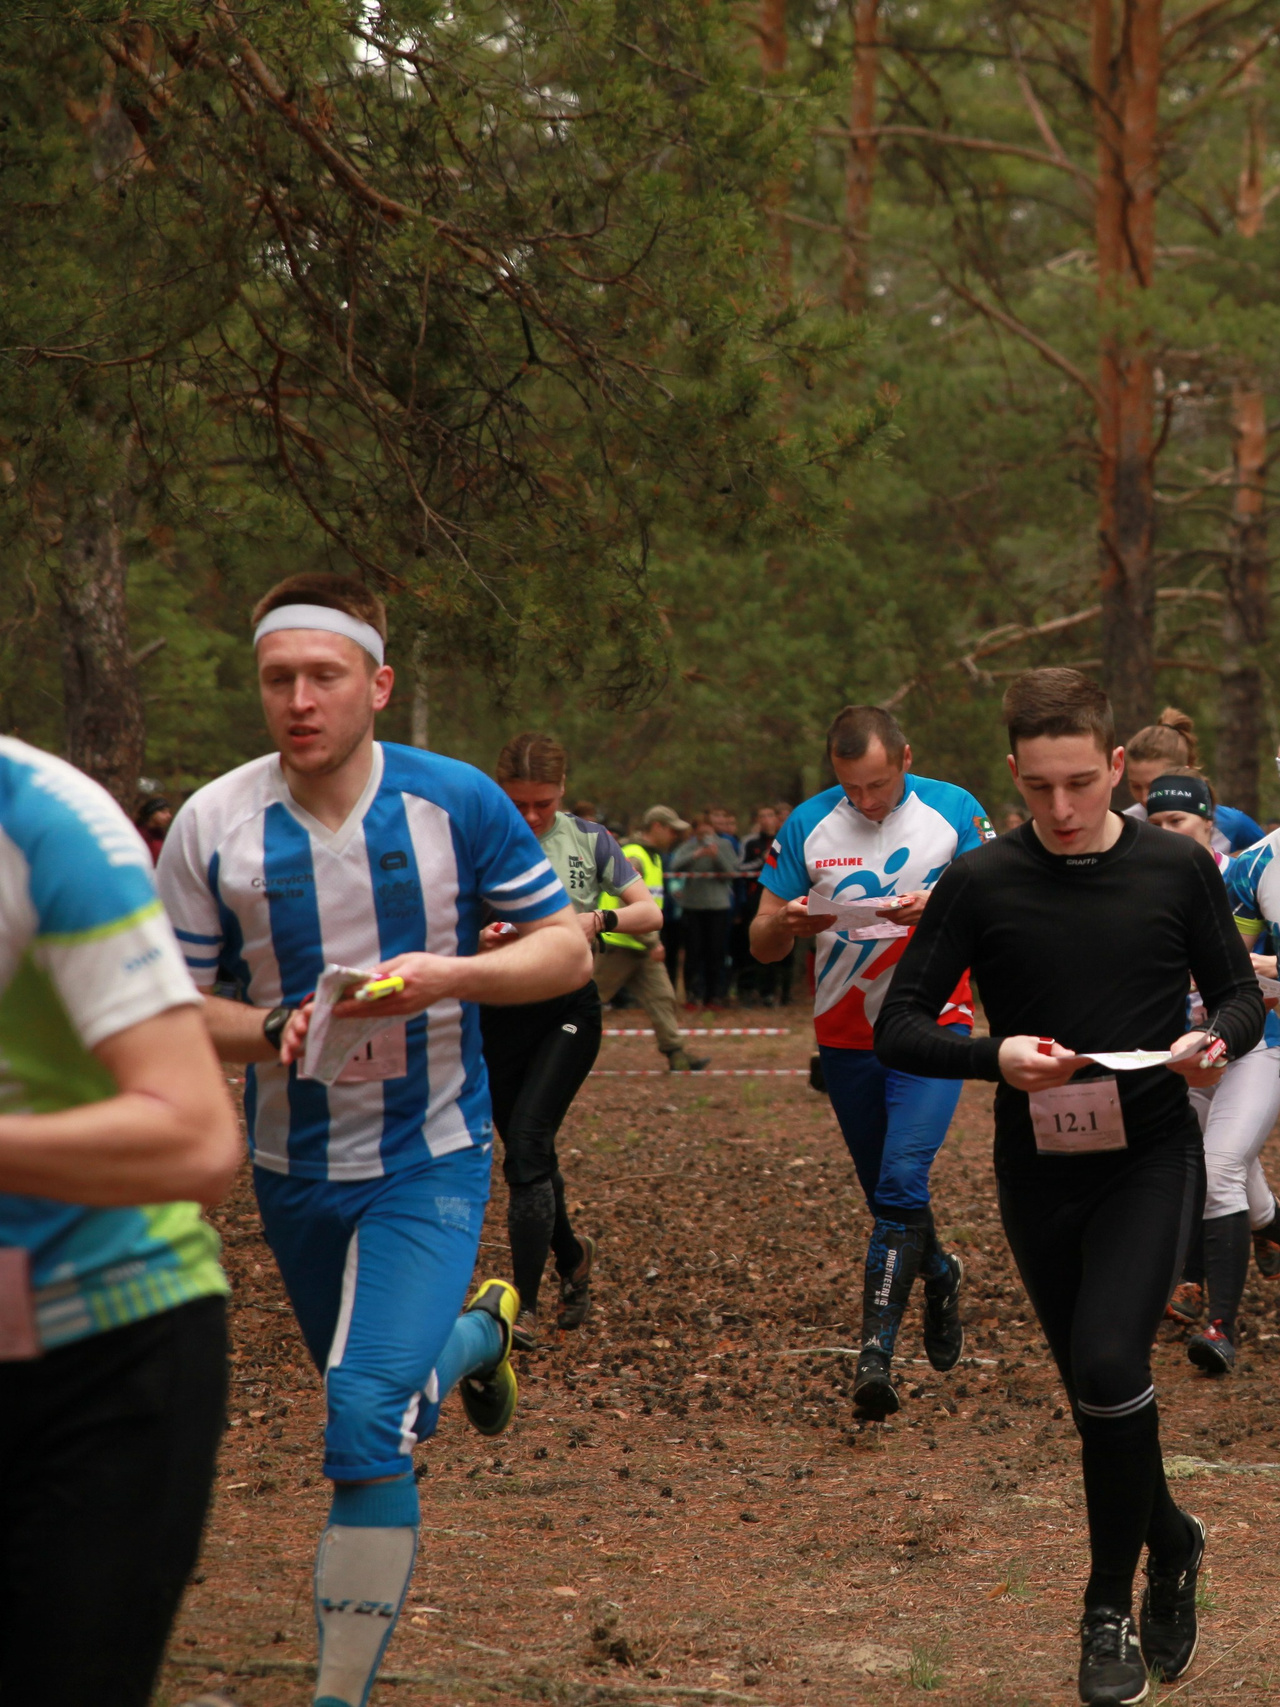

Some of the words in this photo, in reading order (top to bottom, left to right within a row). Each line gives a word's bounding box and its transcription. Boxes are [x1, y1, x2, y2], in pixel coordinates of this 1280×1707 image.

[815, 857, 863, 869] REDLINE
[251, 873, 315, 888] Gurevich
[1052, 1110, 1098, 1133] 12.1
